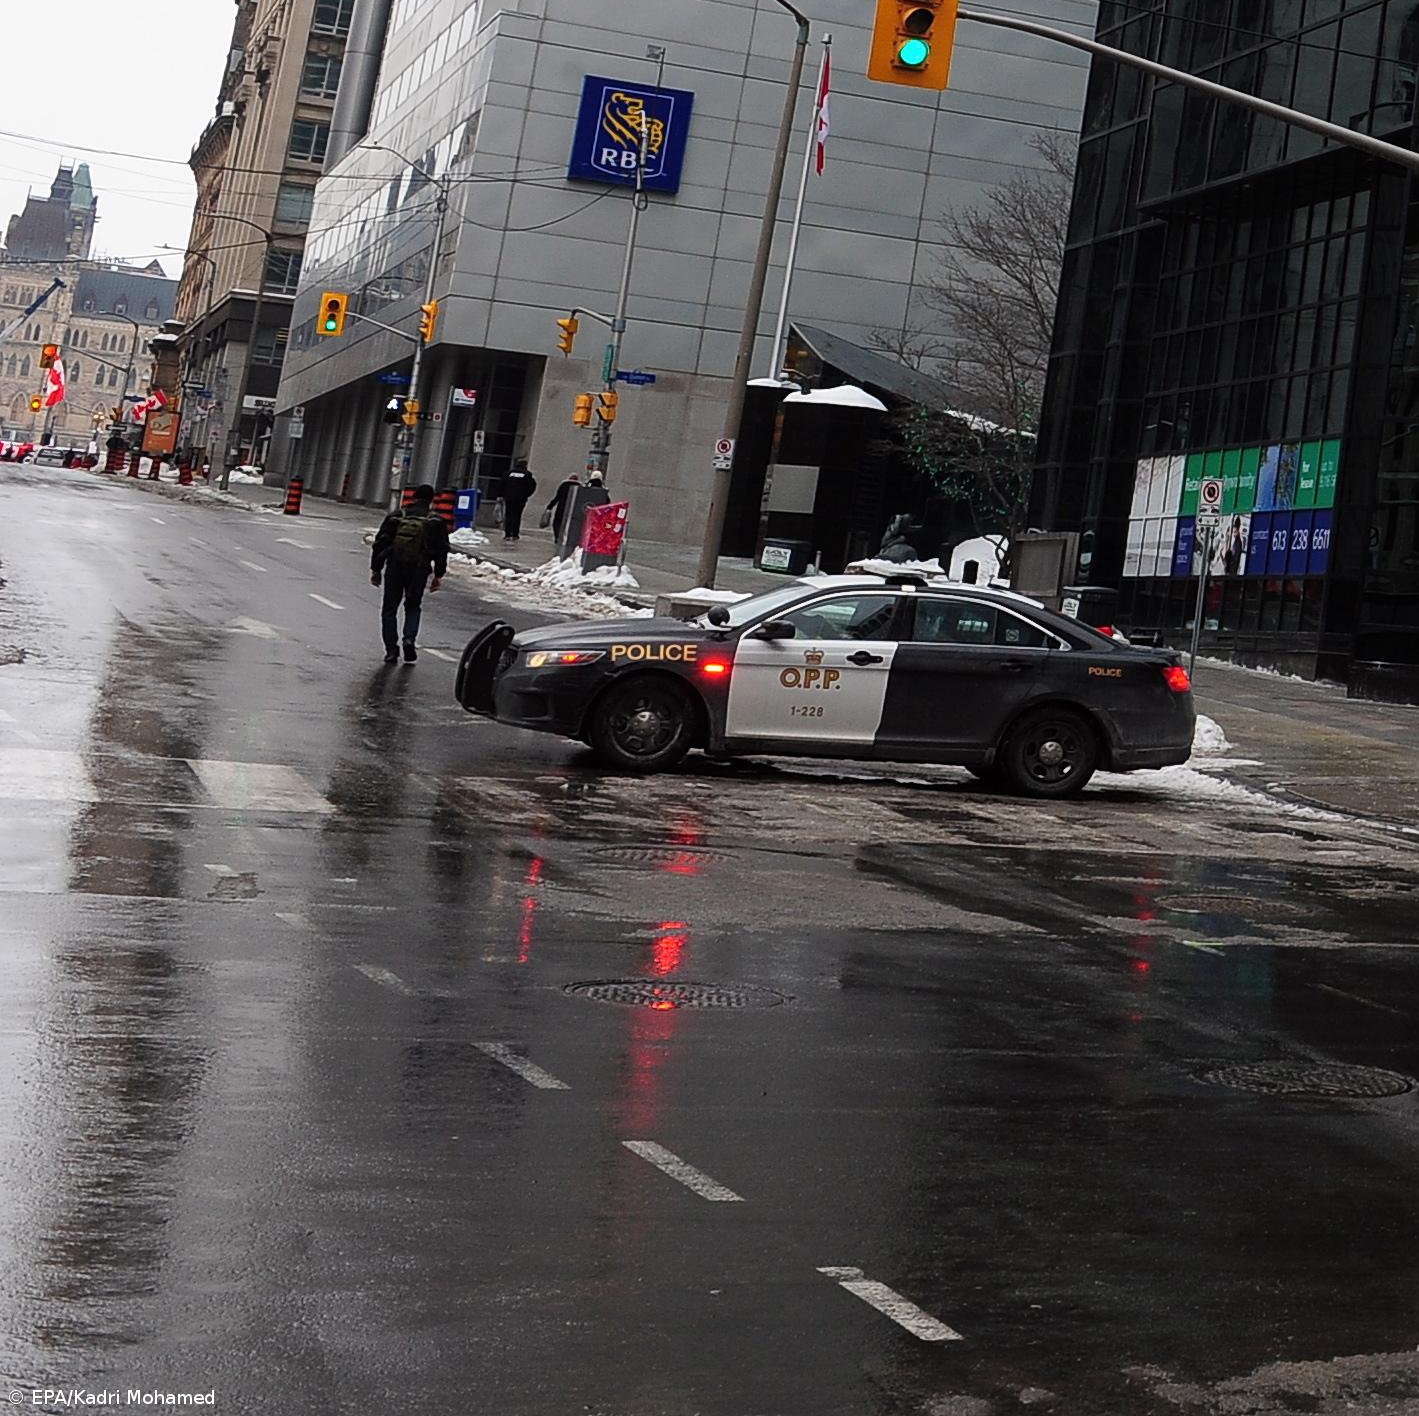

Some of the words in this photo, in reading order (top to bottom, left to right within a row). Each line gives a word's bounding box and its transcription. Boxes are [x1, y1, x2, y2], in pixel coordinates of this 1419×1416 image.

[1272, 529, 1288, 551] 613
[610, 644, 698, 662] POLICE
[779, 667, 842, 691] O.P.P.
[1088, 666, 1123, 678] POLICE
[790, 705, 825, 718] 1-228
